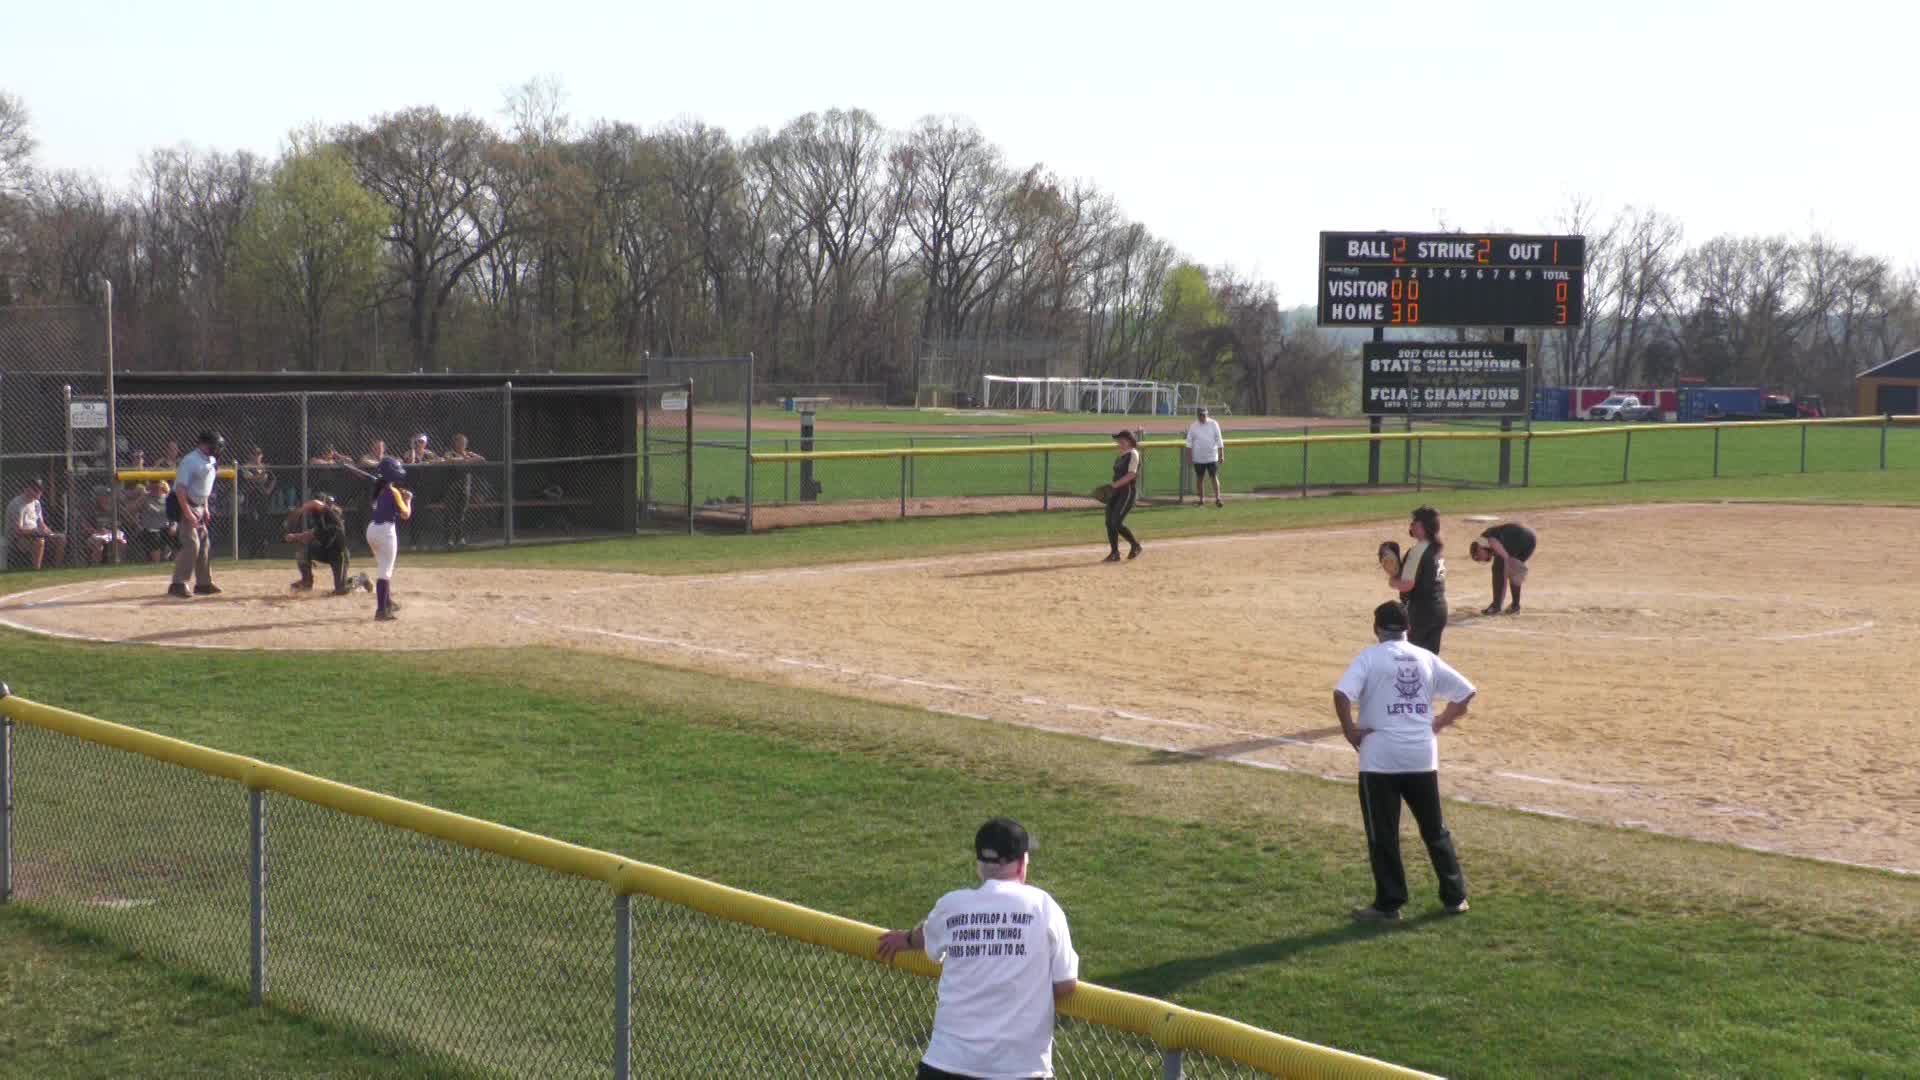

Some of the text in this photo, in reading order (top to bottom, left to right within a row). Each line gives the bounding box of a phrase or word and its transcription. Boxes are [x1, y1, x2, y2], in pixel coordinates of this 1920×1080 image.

[1348, 240, 1390, 257] BALL
[1391, 238, 1406, 264] 2
[1417, 242, 1475, 259] STRIKE
[1477, 239, 1490, 264] 2
[1509, 243, 1542, 260] OUT
[1395, 268, 1569, 280] 1 2 3 4 5 6 7 8 9 TOTAL
[1328, 281, 1388, 297] VISITOR
[1556, 281, 1567, 303] 0
[1331, 303, 1384, 320] HOME
[1556, 304, 1566, 324] 3
[1398, 349, 1495, 358] 2017 CIAC CLASS LL
[1370, 359, 1520, 372] STATE CHAMPIONS
[1370, 387, 1520, 400] FCIAC CHAMPIONS
[1386, 703, 1413, 715] LET'S
[970, 912, 1001, 925] DEVELOP
[1002, 912, 1008, 924] A
[959, 928, 980, 941] DOING
[983, 928, 995, 940] THE
[997, 928, 1022, 940] THINGS
[965, 944, 987, 957] DON'T
[988, 944, 1002, 956] LIKE
[1004, 944, 1014, 956] TO
